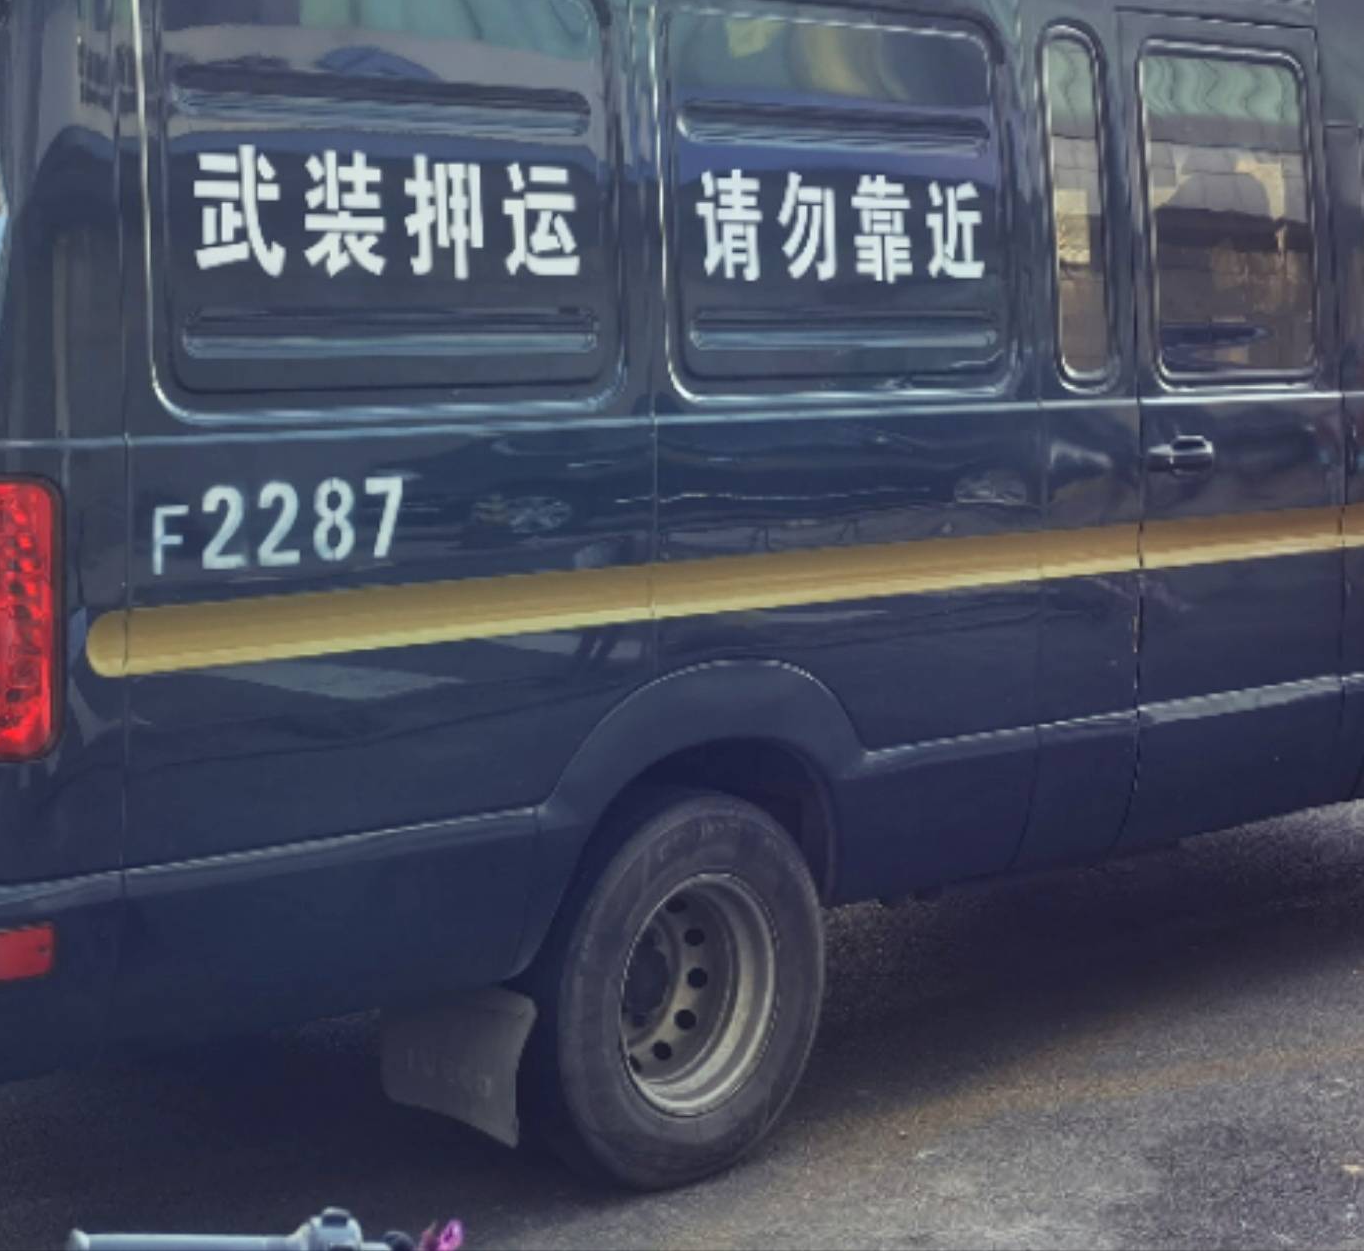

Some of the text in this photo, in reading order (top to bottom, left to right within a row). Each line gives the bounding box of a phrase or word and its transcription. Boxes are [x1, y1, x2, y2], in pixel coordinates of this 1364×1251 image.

[193, 144, 580, 280] 武装押运
[695, 168, 986, 283] 请勿靠近
[152, 476, 404, 575] F2287
